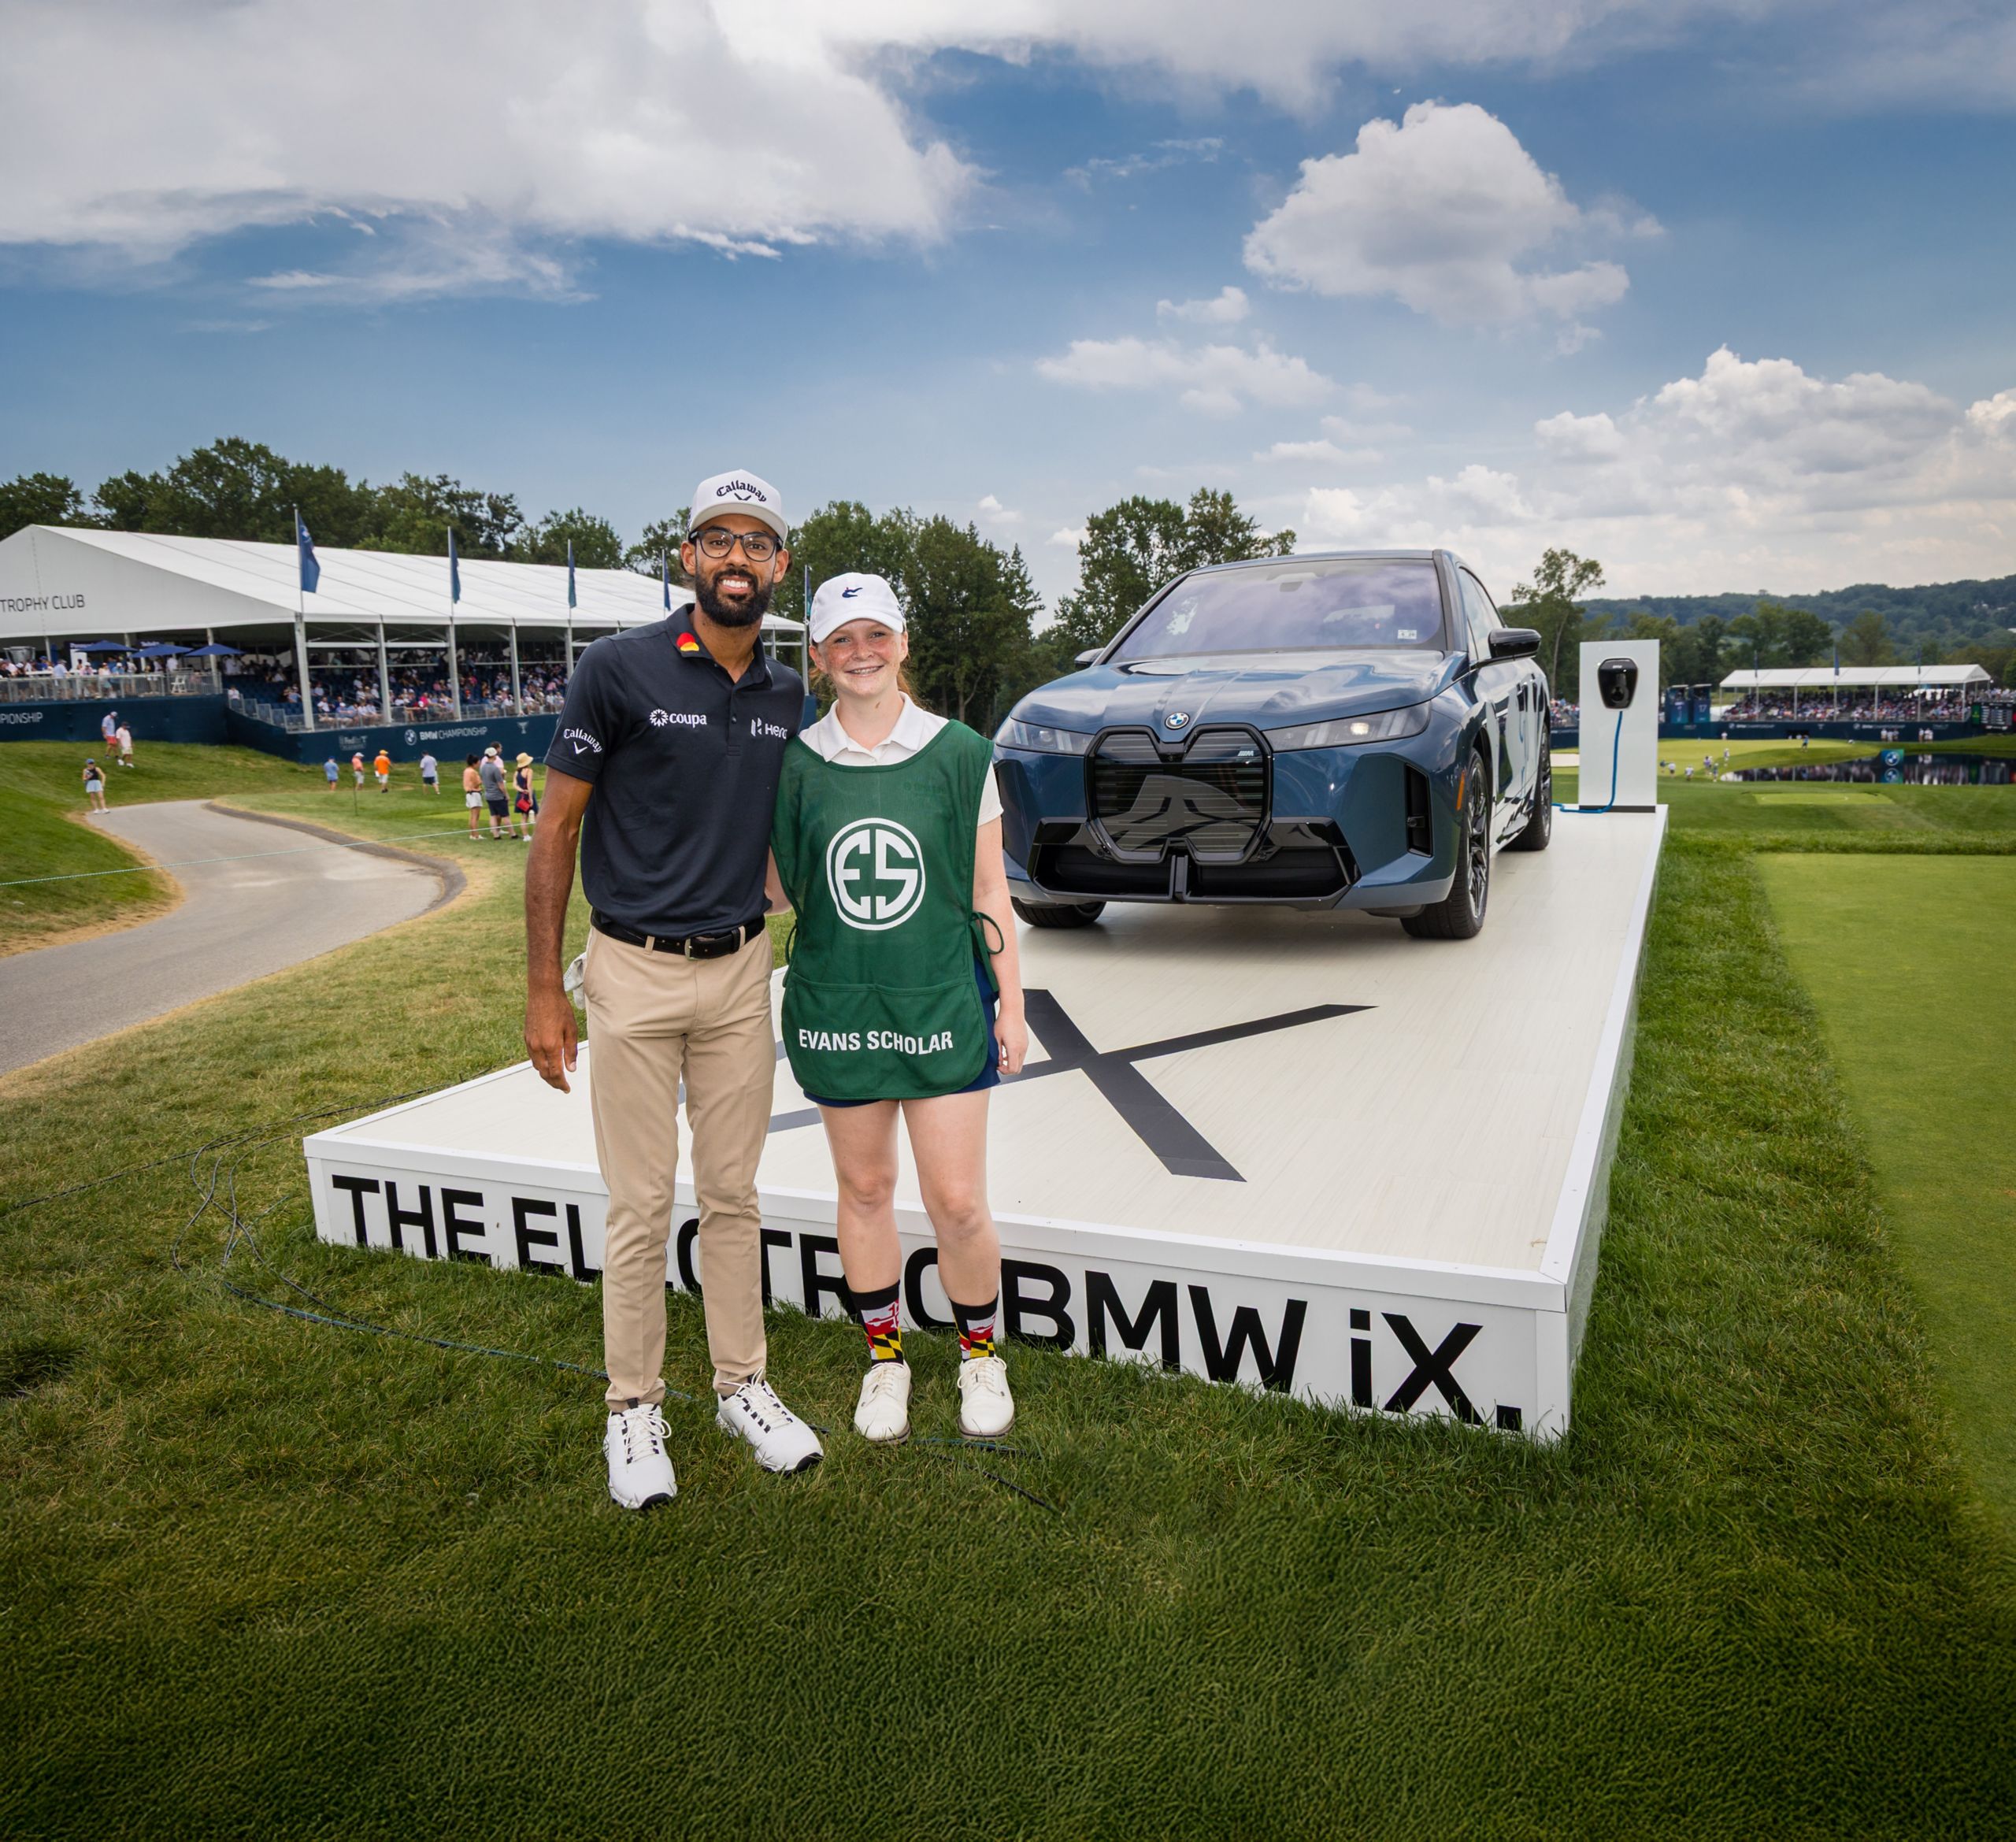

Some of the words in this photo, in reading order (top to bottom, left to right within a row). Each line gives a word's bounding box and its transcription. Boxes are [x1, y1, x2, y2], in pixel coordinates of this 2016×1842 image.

[716, 480, 767, 502] Callaway
[0, 596, 49, 613] TROPHY
[52, 594, 85, 610] CLUB
[669, 712, 707, 728] coupa
[419, 730, 438, 741] BMW
[438, 726, 488, 739] CHAMPIONSHIP
[563, 728, 603, 754] Callaway
[835, 828, 919, 921] ES
[799, 1028, 862, 1051] EVANS
[866, 1030, 954, 1056] SCHOLAR
[331, 1173, 493, 1269] THE
[1000, 1258, 1308, 1394] BMW
